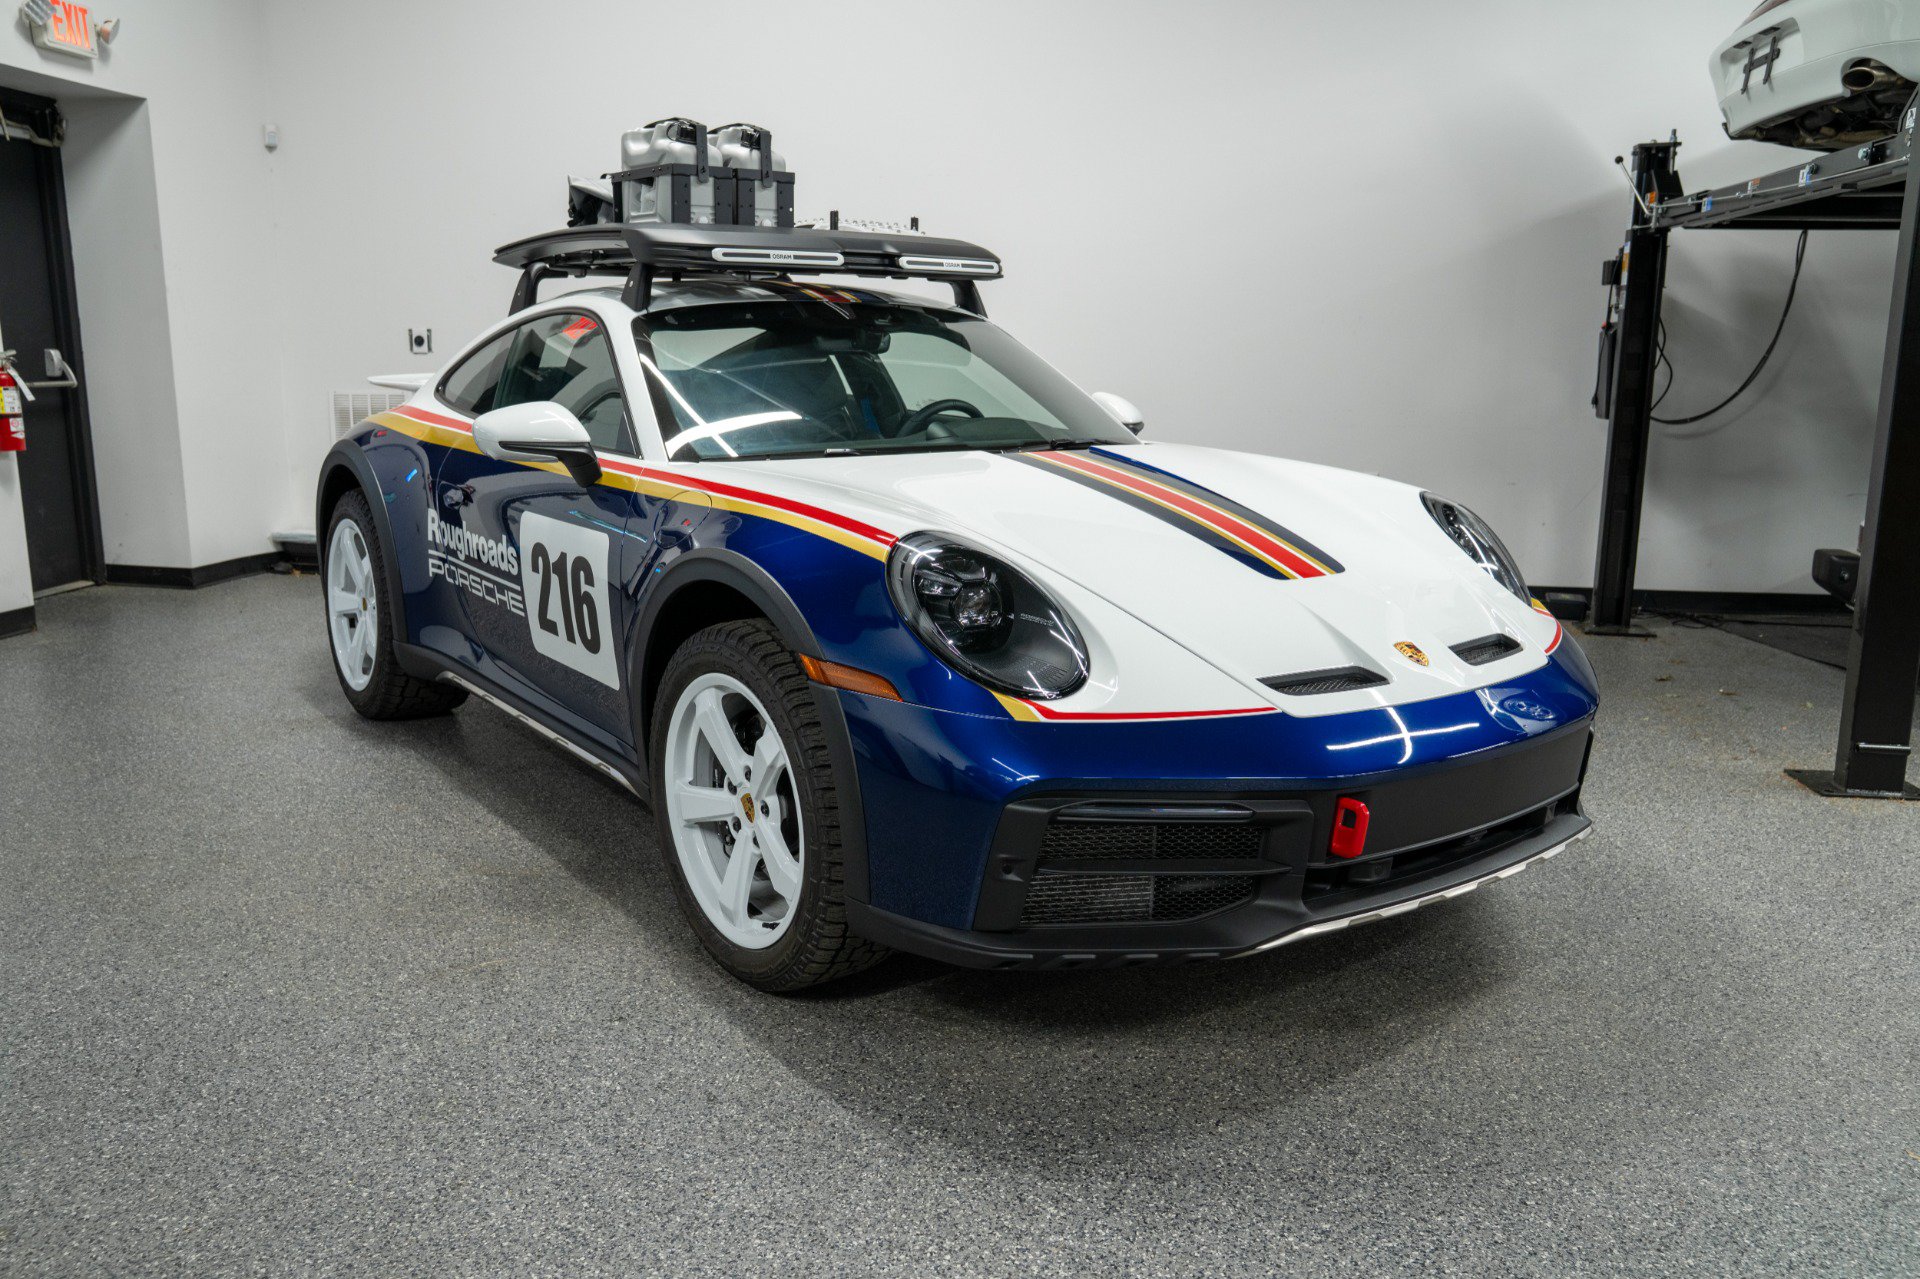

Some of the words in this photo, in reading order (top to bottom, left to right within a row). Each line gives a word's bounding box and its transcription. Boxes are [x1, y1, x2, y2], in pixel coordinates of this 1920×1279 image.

[50, 0, 91, 48] EXIT
[427, 508, 519, 576] Roughroads
[428, 557, 526, 618] PORSCHE
[531, 541, 601, 655] 216
